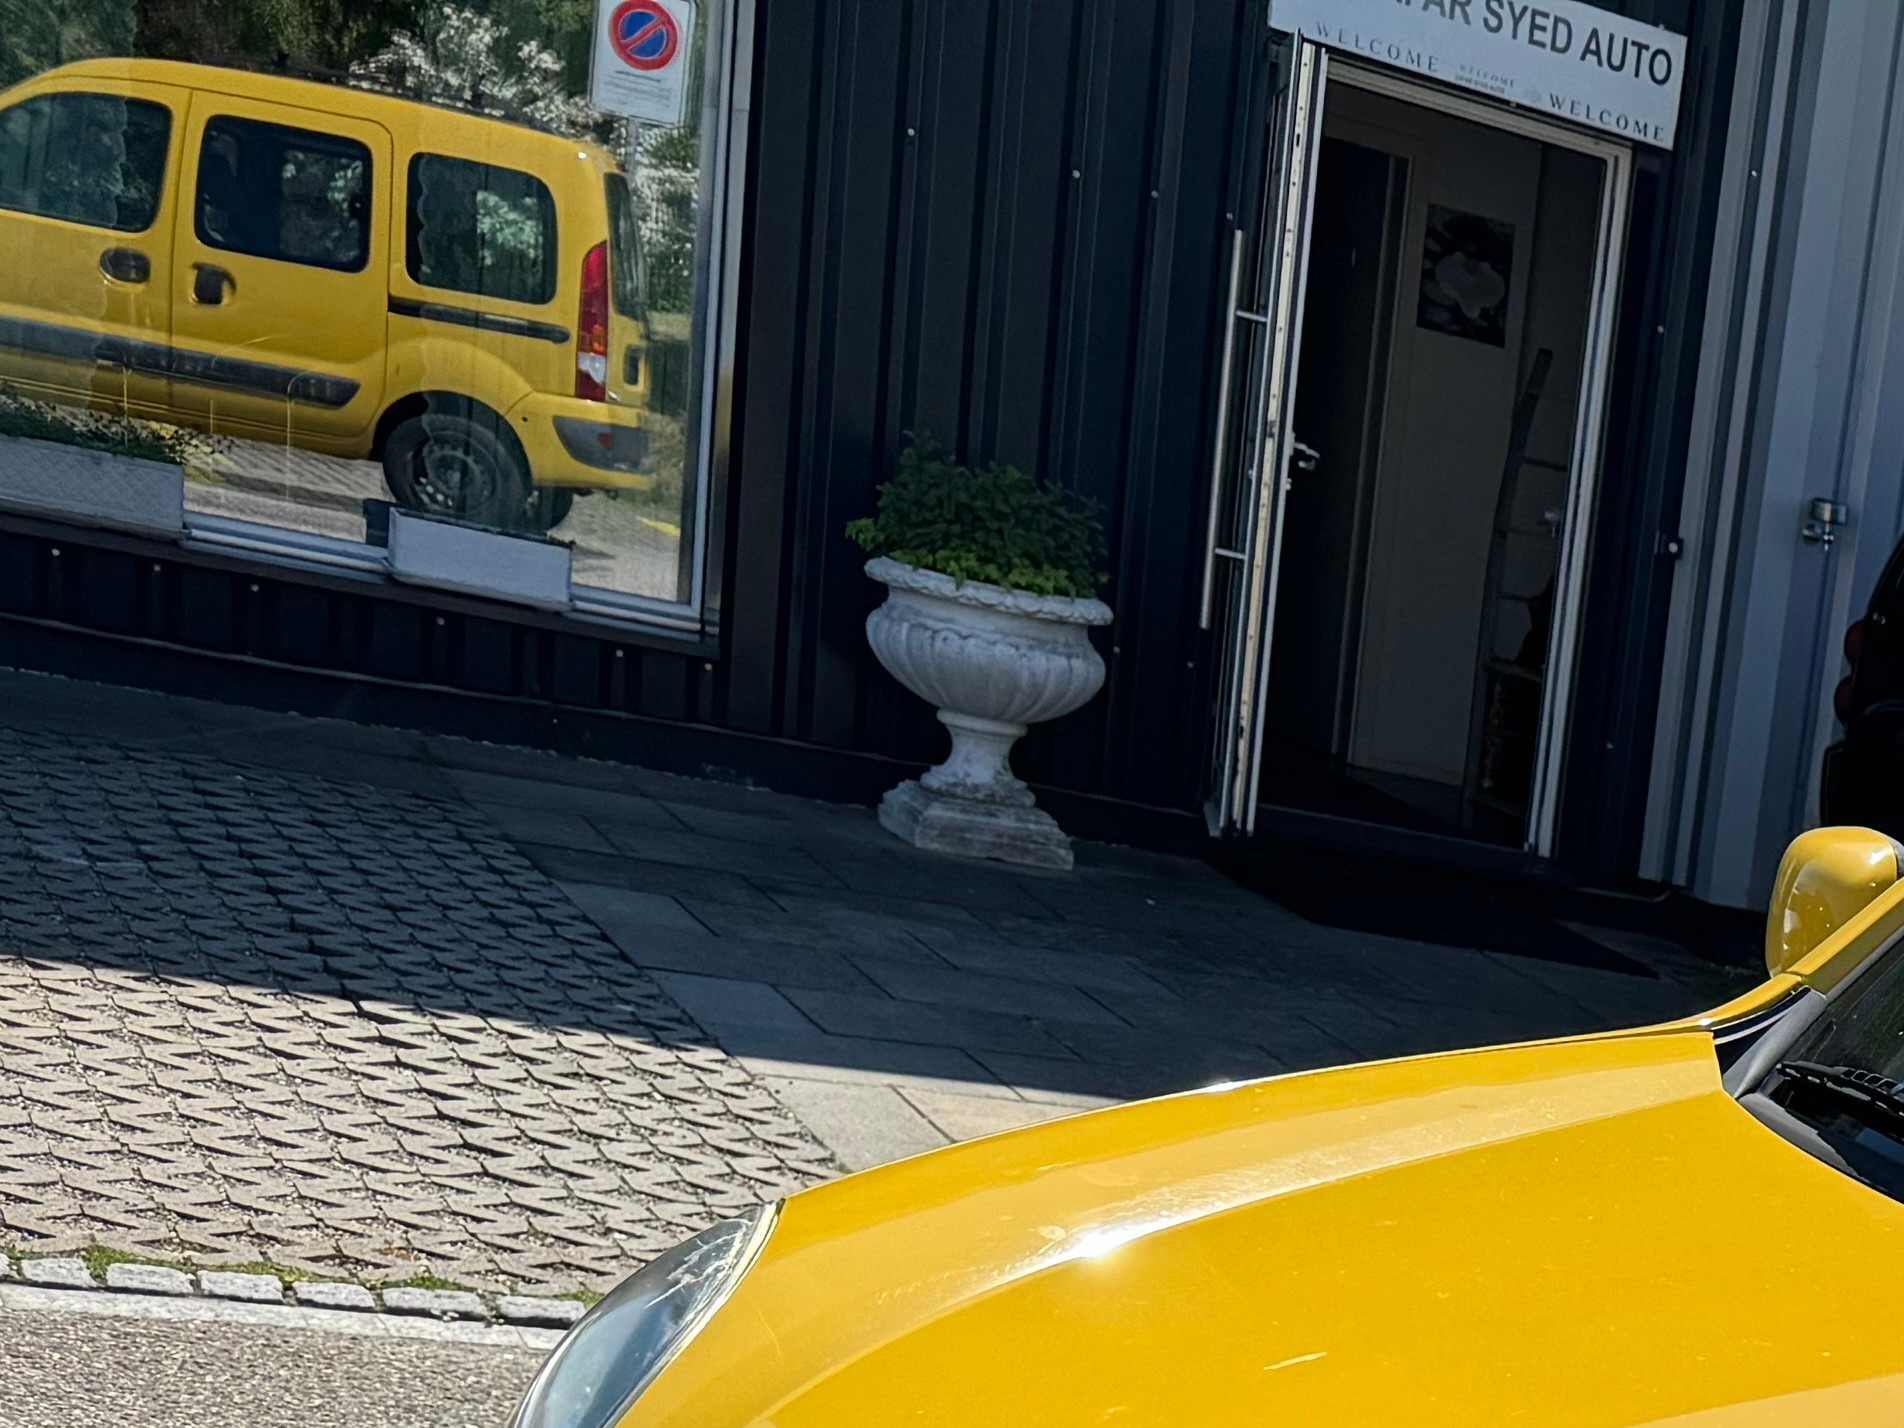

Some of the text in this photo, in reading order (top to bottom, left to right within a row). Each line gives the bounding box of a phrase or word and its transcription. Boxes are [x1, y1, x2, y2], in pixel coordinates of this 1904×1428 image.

[1316, 21, 1440, 74] WELCOME
[1396, 0, 1672, 86] AR SYED AUTO
[1550, 93, 1665, 142] WELCOME
